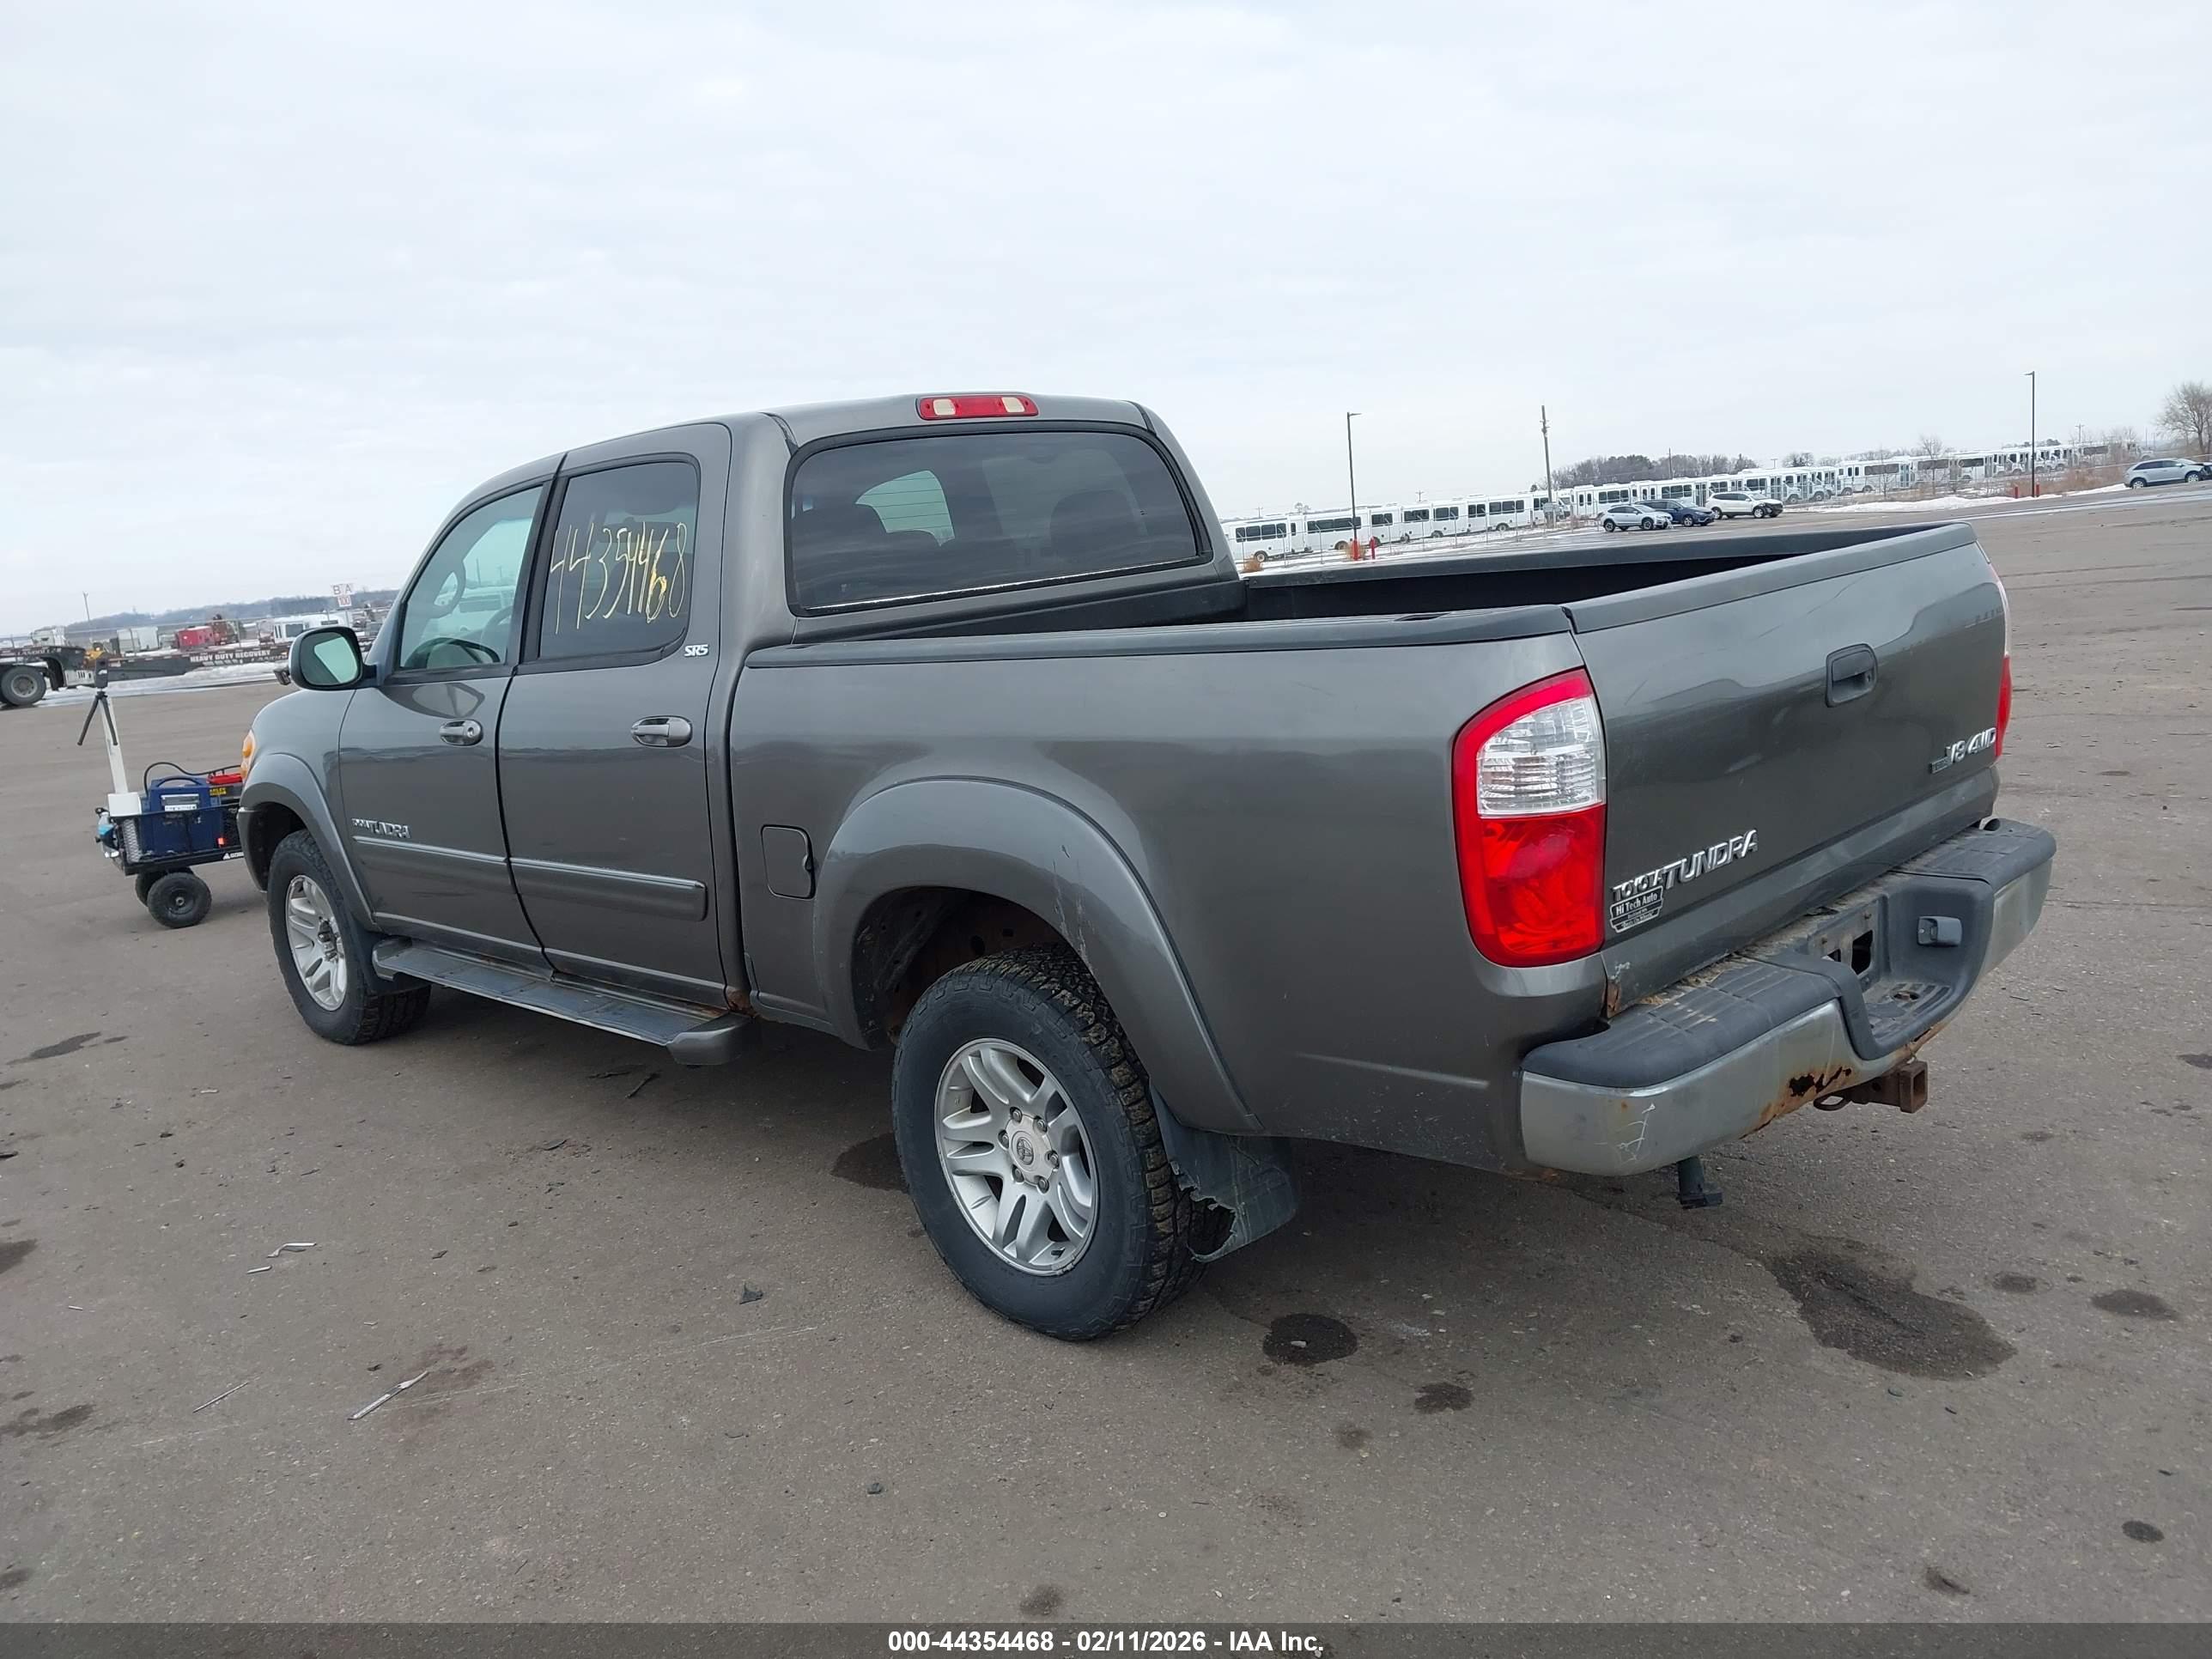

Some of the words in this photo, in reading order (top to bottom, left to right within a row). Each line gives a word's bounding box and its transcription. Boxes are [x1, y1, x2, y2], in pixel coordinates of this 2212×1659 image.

[550, 521, 688, 635] 44354468
[190, 654, 213, 663] HEAVY
[235, 649, 270, 659] RECOVERY
[684, 643, 709, 658] SR5
[1612, 868, 1664, 902] TOYOTA
[1662, 829, 1759, 890] TUNDRA
[1615, 903, 1625, 916] Hi
[1626, 897, 1641, 912] Tech
[1642, 892, 1658, 906] Auto
